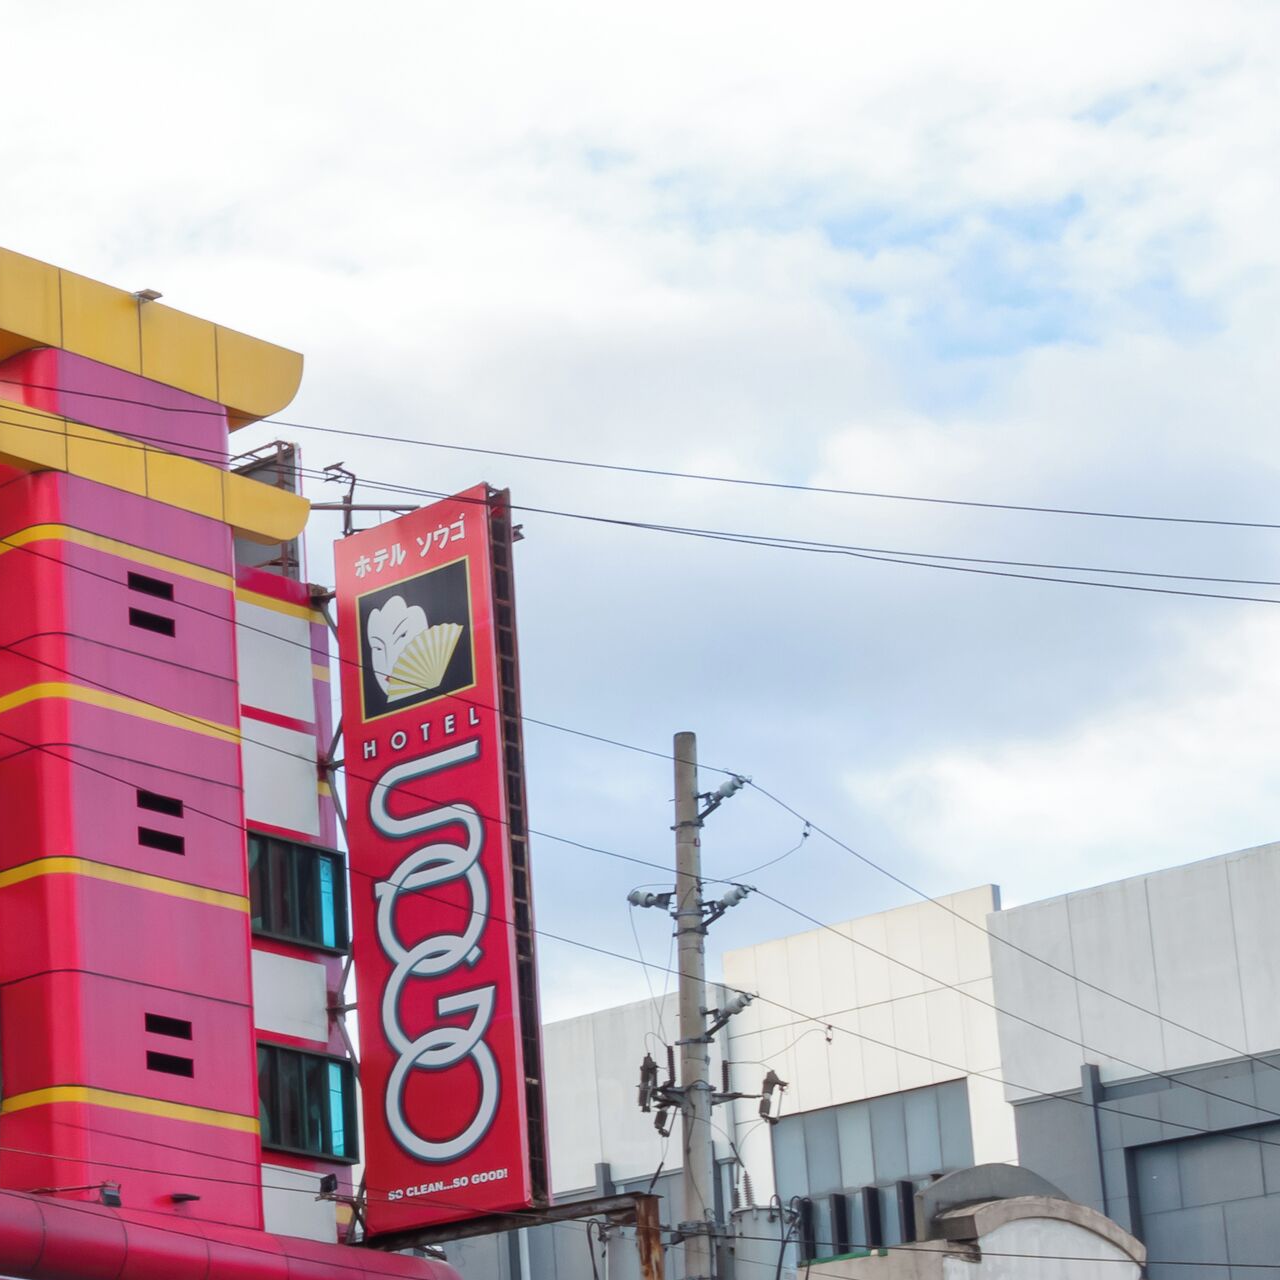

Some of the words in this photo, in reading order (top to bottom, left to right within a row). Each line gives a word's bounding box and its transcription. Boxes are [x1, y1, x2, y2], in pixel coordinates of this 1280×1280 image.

[354, 543, 406, 579] ホテル
[417, 513, 466, 558] ソウゴ
[362, 707, 481, 761] HOTEL
[369, 738, 502, 1163] SOGO
[388, 1188, 404, 1201] SO
[471, 1168, 508, 1185] GOOD!
